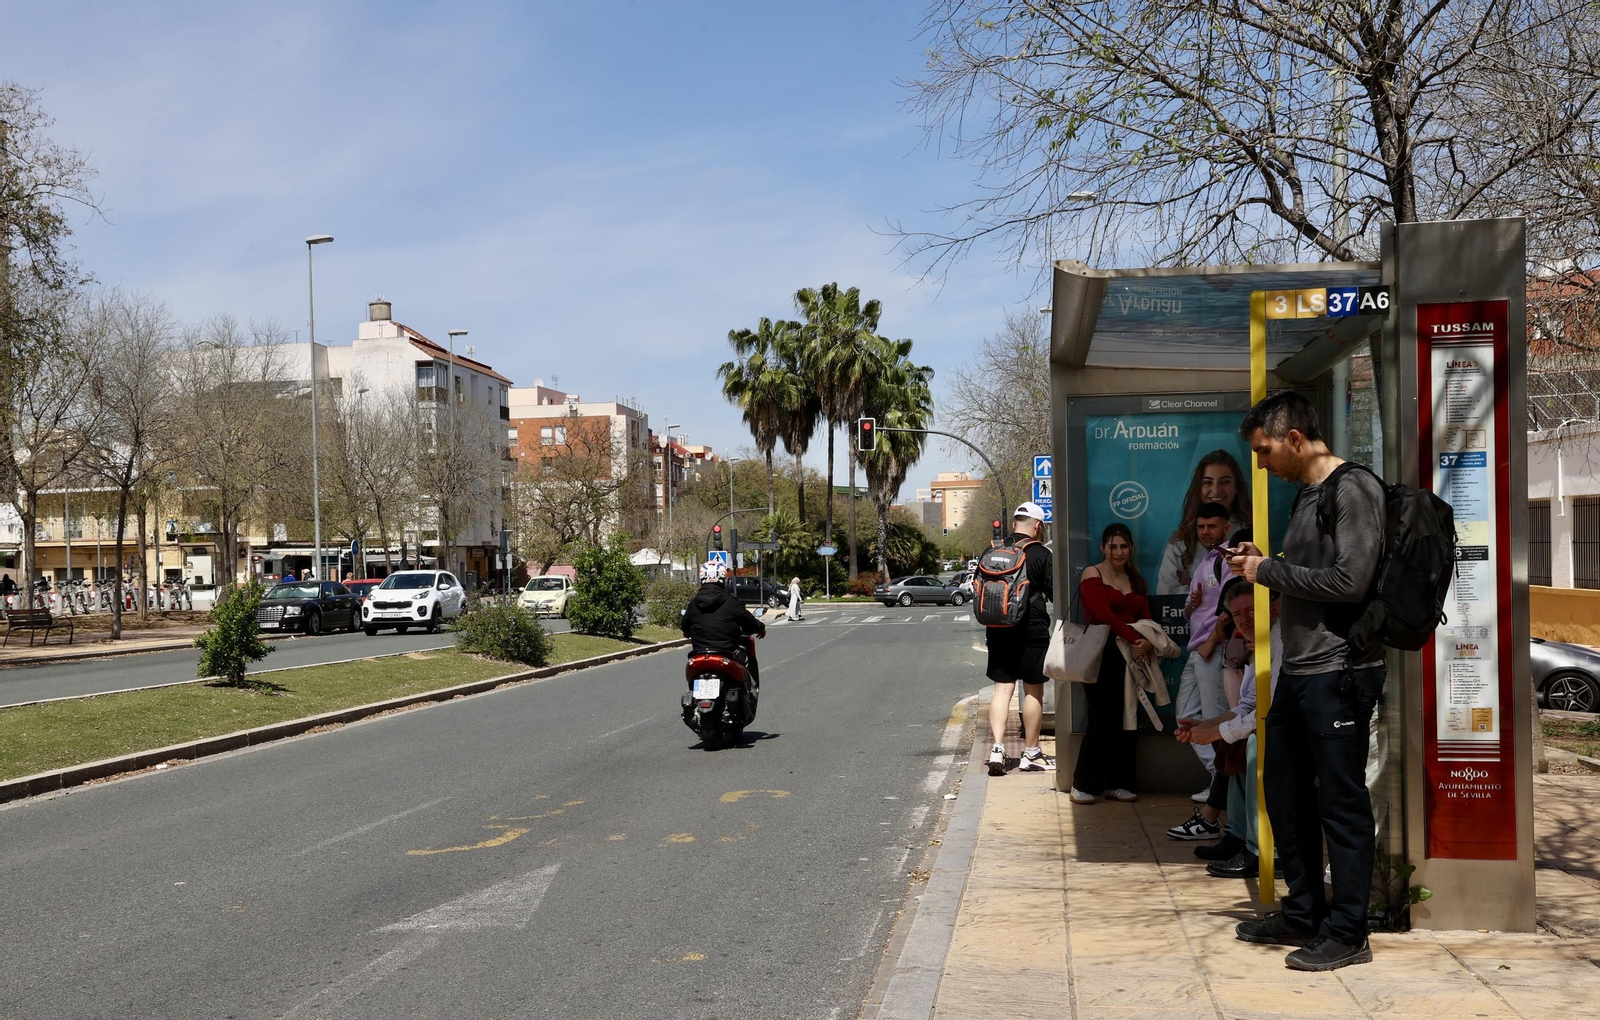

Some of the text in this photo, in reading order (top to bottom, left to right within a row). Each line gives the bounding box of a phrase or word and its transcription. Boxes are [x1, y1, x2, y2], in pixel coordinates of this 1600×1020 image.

[1275, 291, 1390, 313] 3 LS 37 A6
[1430, 322, 1494, 333] TUSSAM
[1446, 360, 1473, 369] LÍNEA
[1161, 399, 1218, 408] Clear Channel
[1440, 455, 1459, 466] 37
[1112, 493, 1147, 508] FP OFICIAL
[1162, 605, 1184, 617] Far
[1455, 643, 1479, 651] LÍNEA
